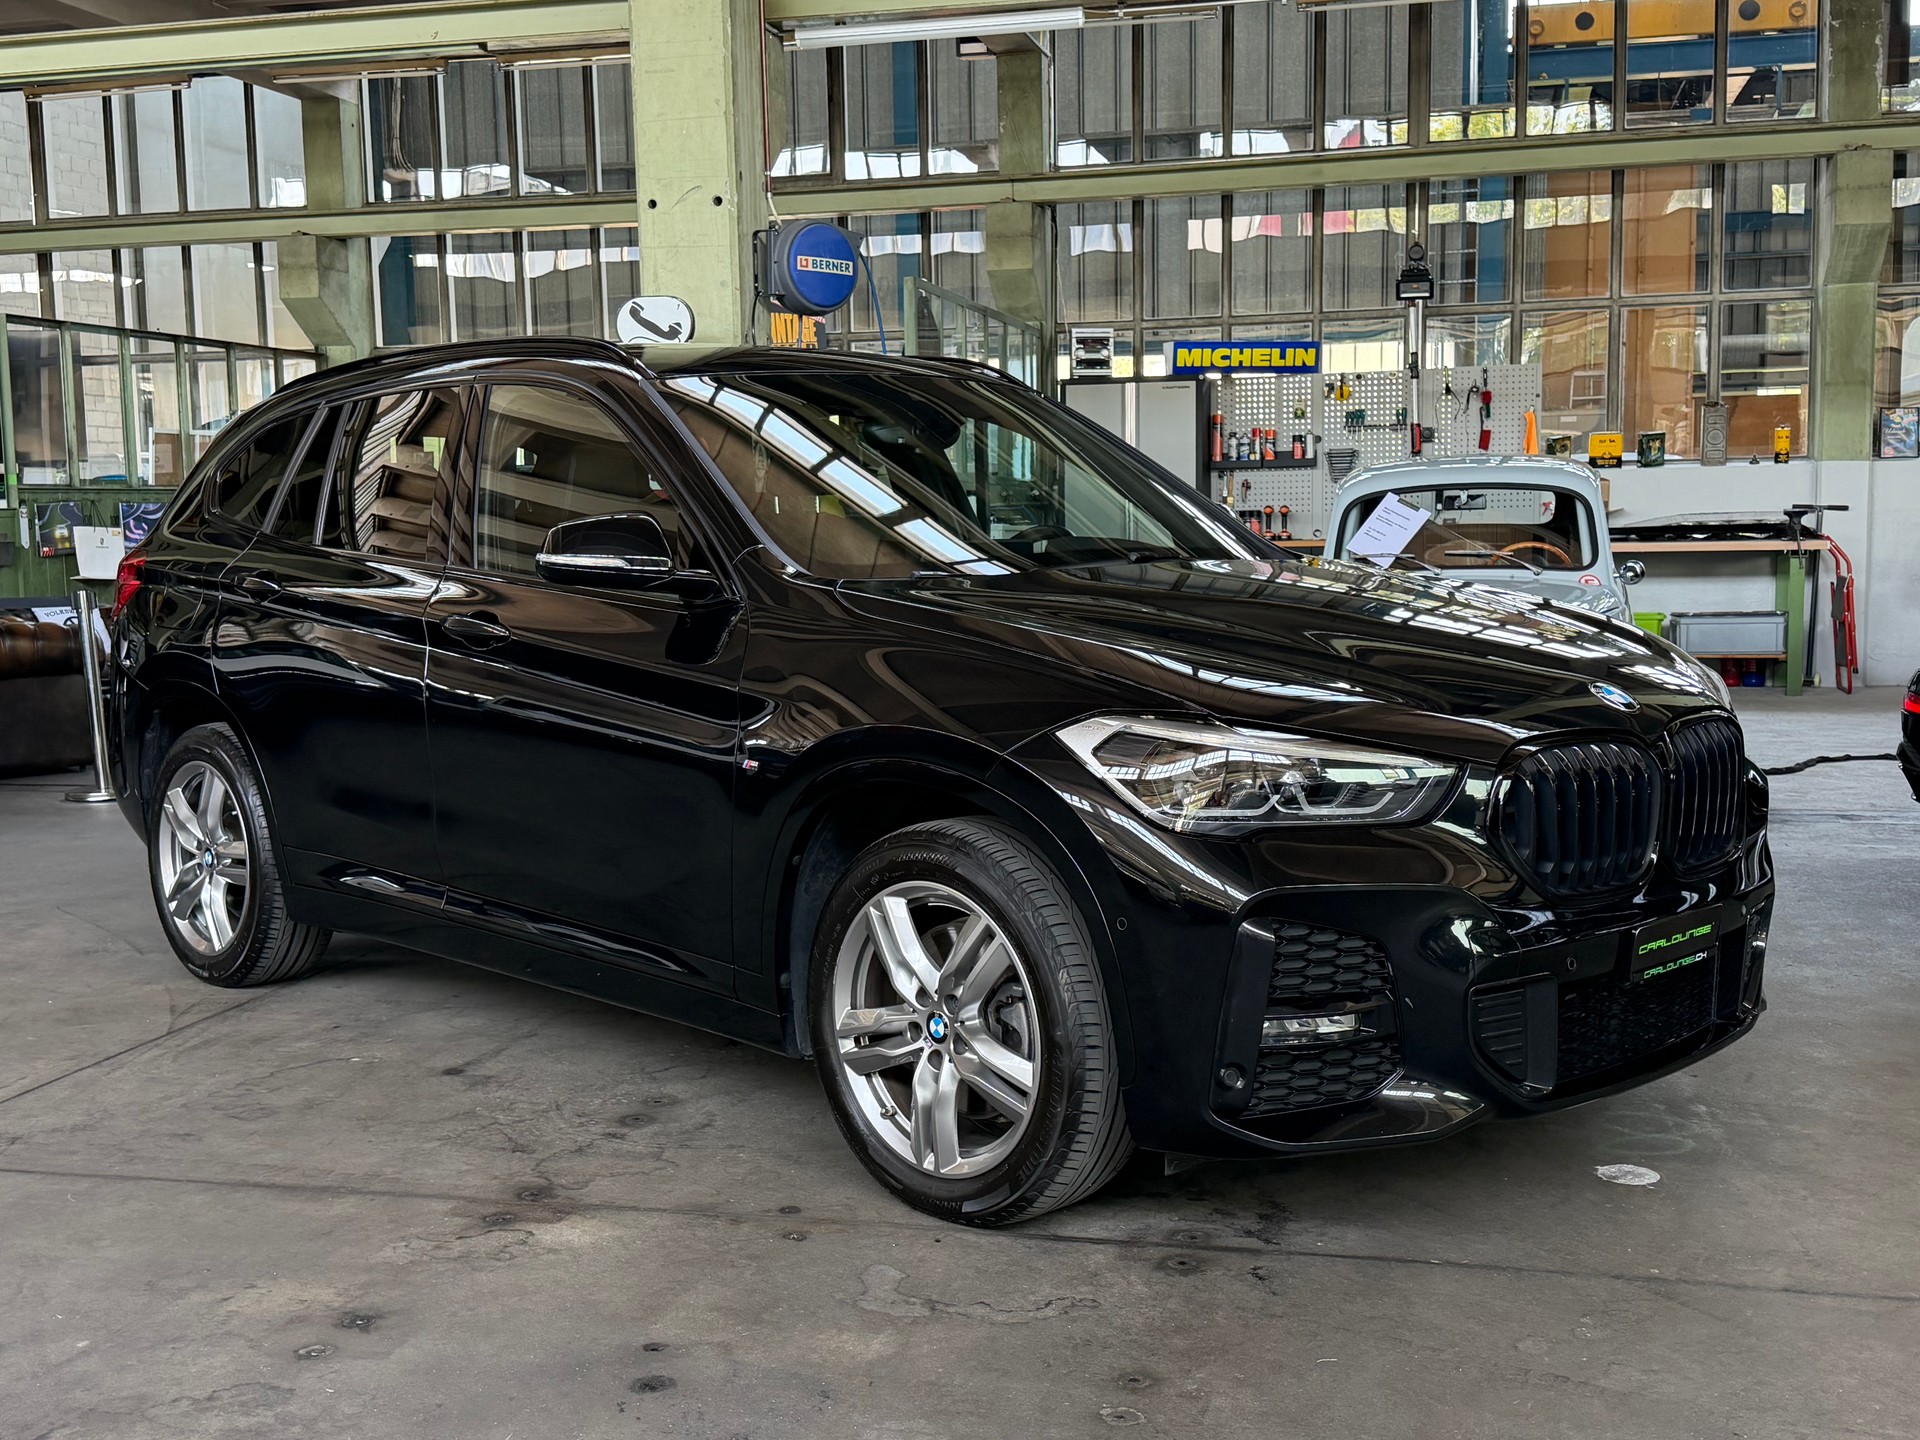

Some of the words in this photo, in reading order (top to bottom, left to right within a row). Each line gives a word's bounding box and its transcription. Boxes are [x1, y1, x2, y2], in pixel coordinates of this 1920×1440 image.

[811, 258, 851, 274] BERNER
[770, 312, 818, 344] INTAGE
[1176, 347, 1317, 367] MICHELIN
[44, 608, 76, 618] VOLKSW
[1638, 924, 1713, 955] CARLOUNGE
[1643, 950, 1708, 979] CARLOUNGE.CH
